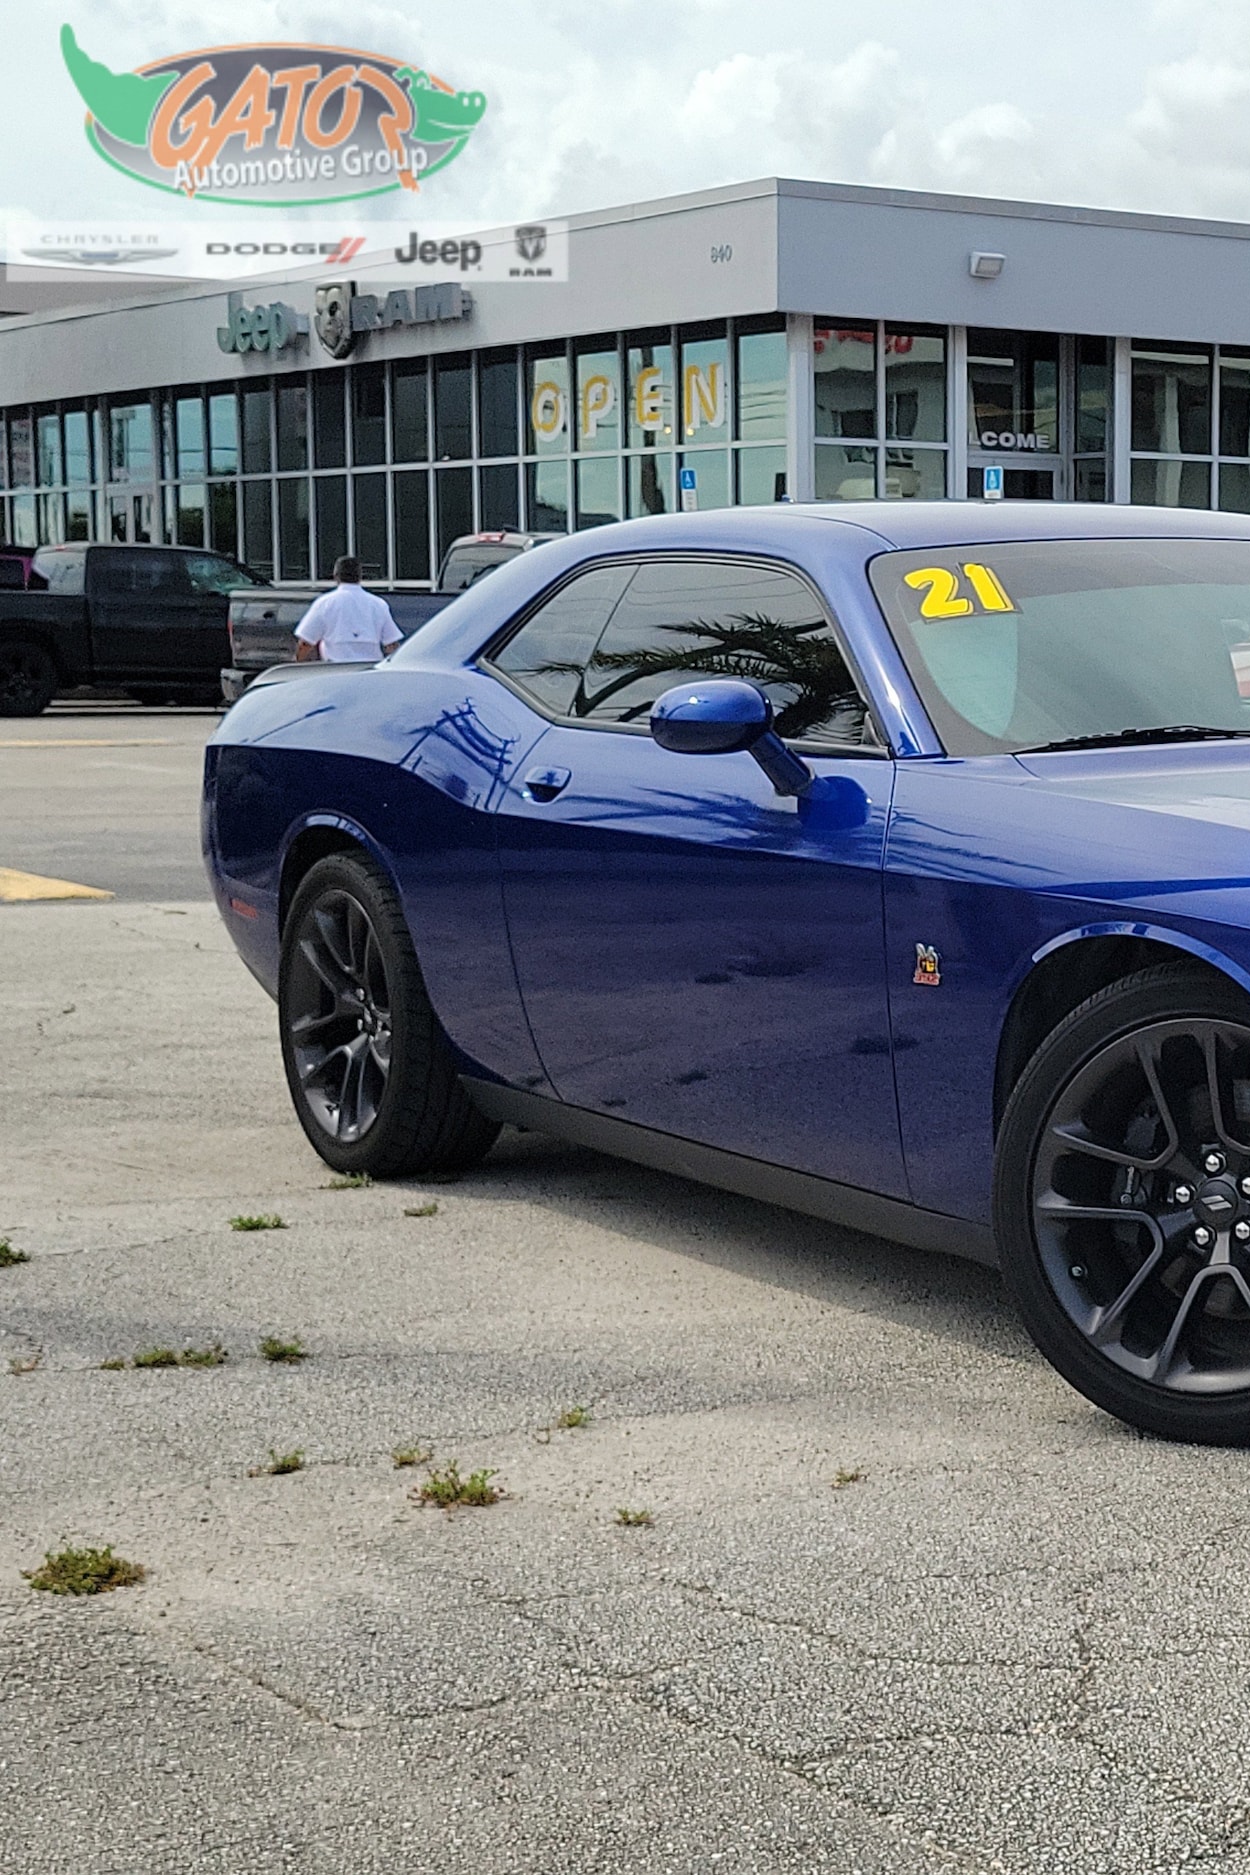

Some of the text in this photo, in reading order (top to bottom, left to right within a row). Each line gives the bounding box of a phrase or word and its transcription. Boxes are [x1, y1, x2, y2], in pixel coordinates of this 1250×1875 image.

[217, 282, 463, 353] Jeep RAM
[532, 362, 725, 442] OPEN
[904, 563, 1014, 618] 21
